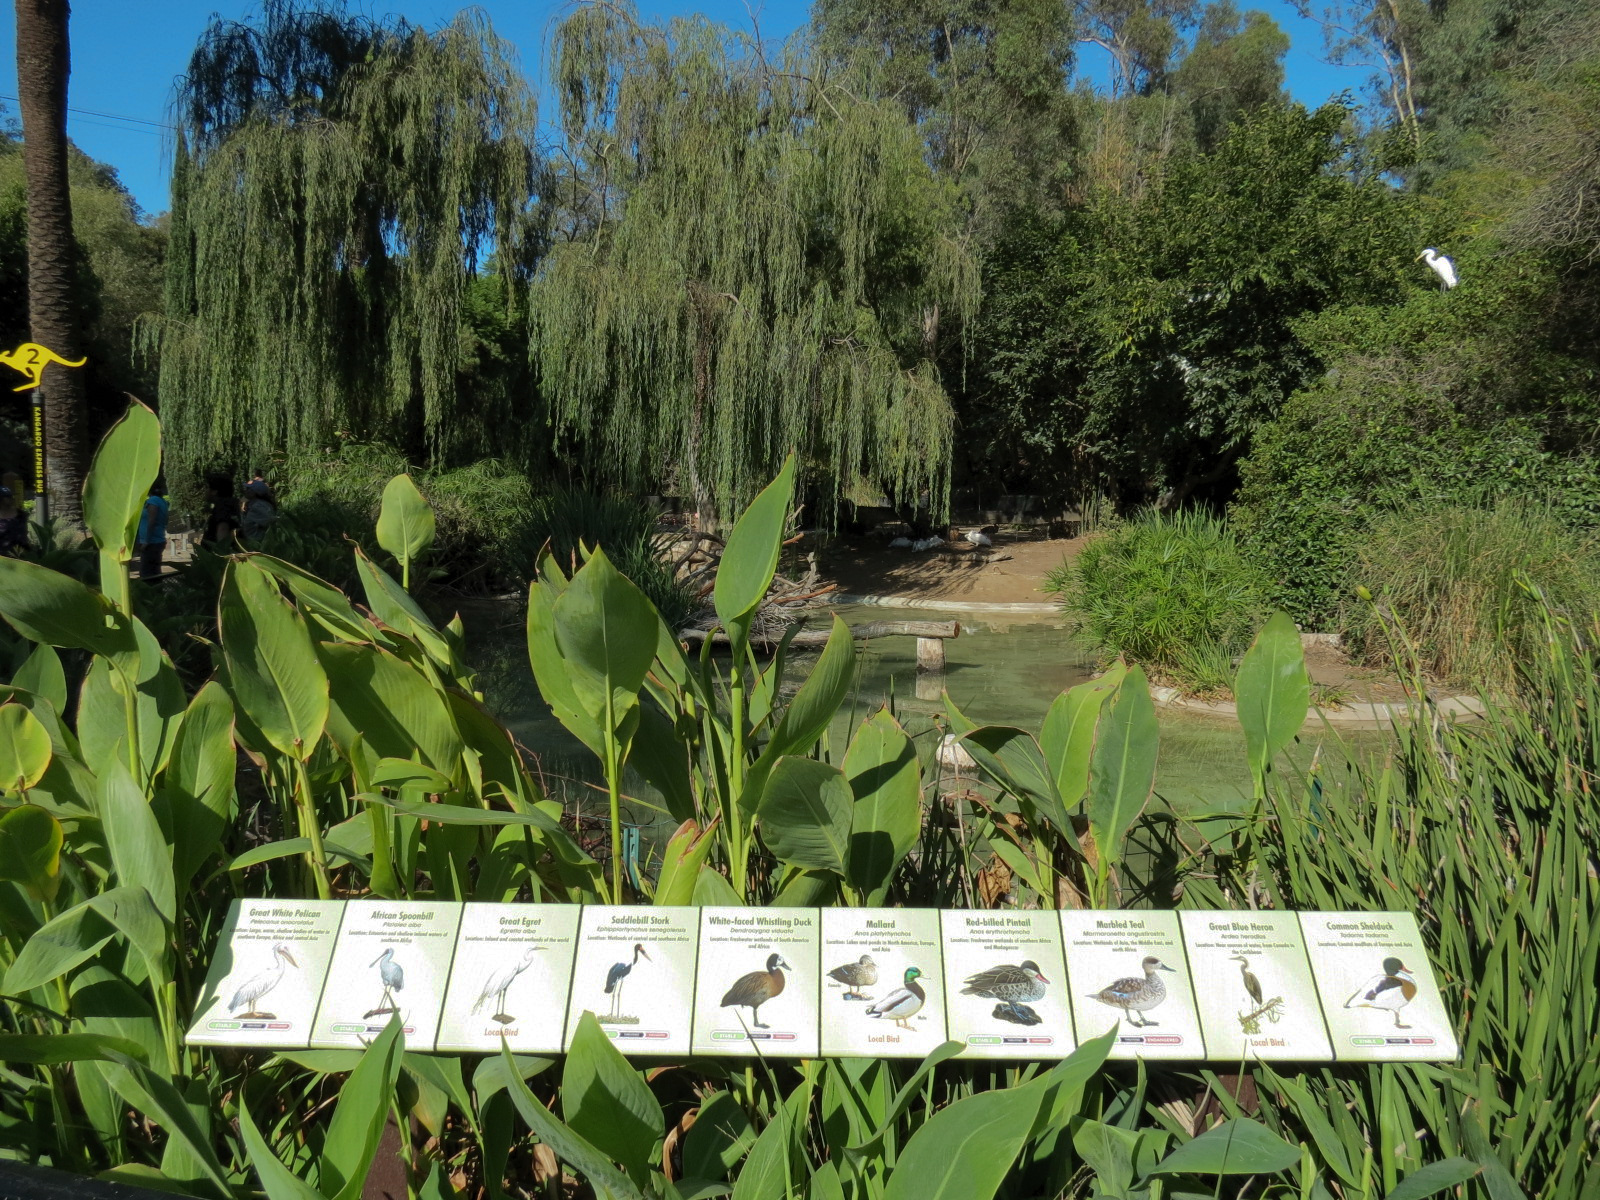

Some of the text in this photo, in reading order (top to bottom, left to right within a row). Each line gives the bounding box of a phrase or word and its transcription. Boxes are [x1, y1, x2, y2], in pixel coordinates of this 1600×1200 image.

[27, 349, 39, 364] 2
[34, 407, 42, 447] KANGAROO
[250, 909, 270, 917] Great
[272, 909, 293, 917] White
[371, 911, 434, 920] African Spoonbill
[500, 917, 541, 927] Great Egret
[612, 916, 669, 924] Saddlebill Stork
[709, 917, 812, 927] White-faced Whistling Duck
[866, 920, 895, 928] Mallard
[966, 918, 1004, 926] Red-billed
[1250, 923, 1273, 931] Heron
[1327, 922, 1393, 930] Common Shelduck
[504, 1028, 519, 1036] Bird
[1250, 1038, 1285, 1046] Local Bird
